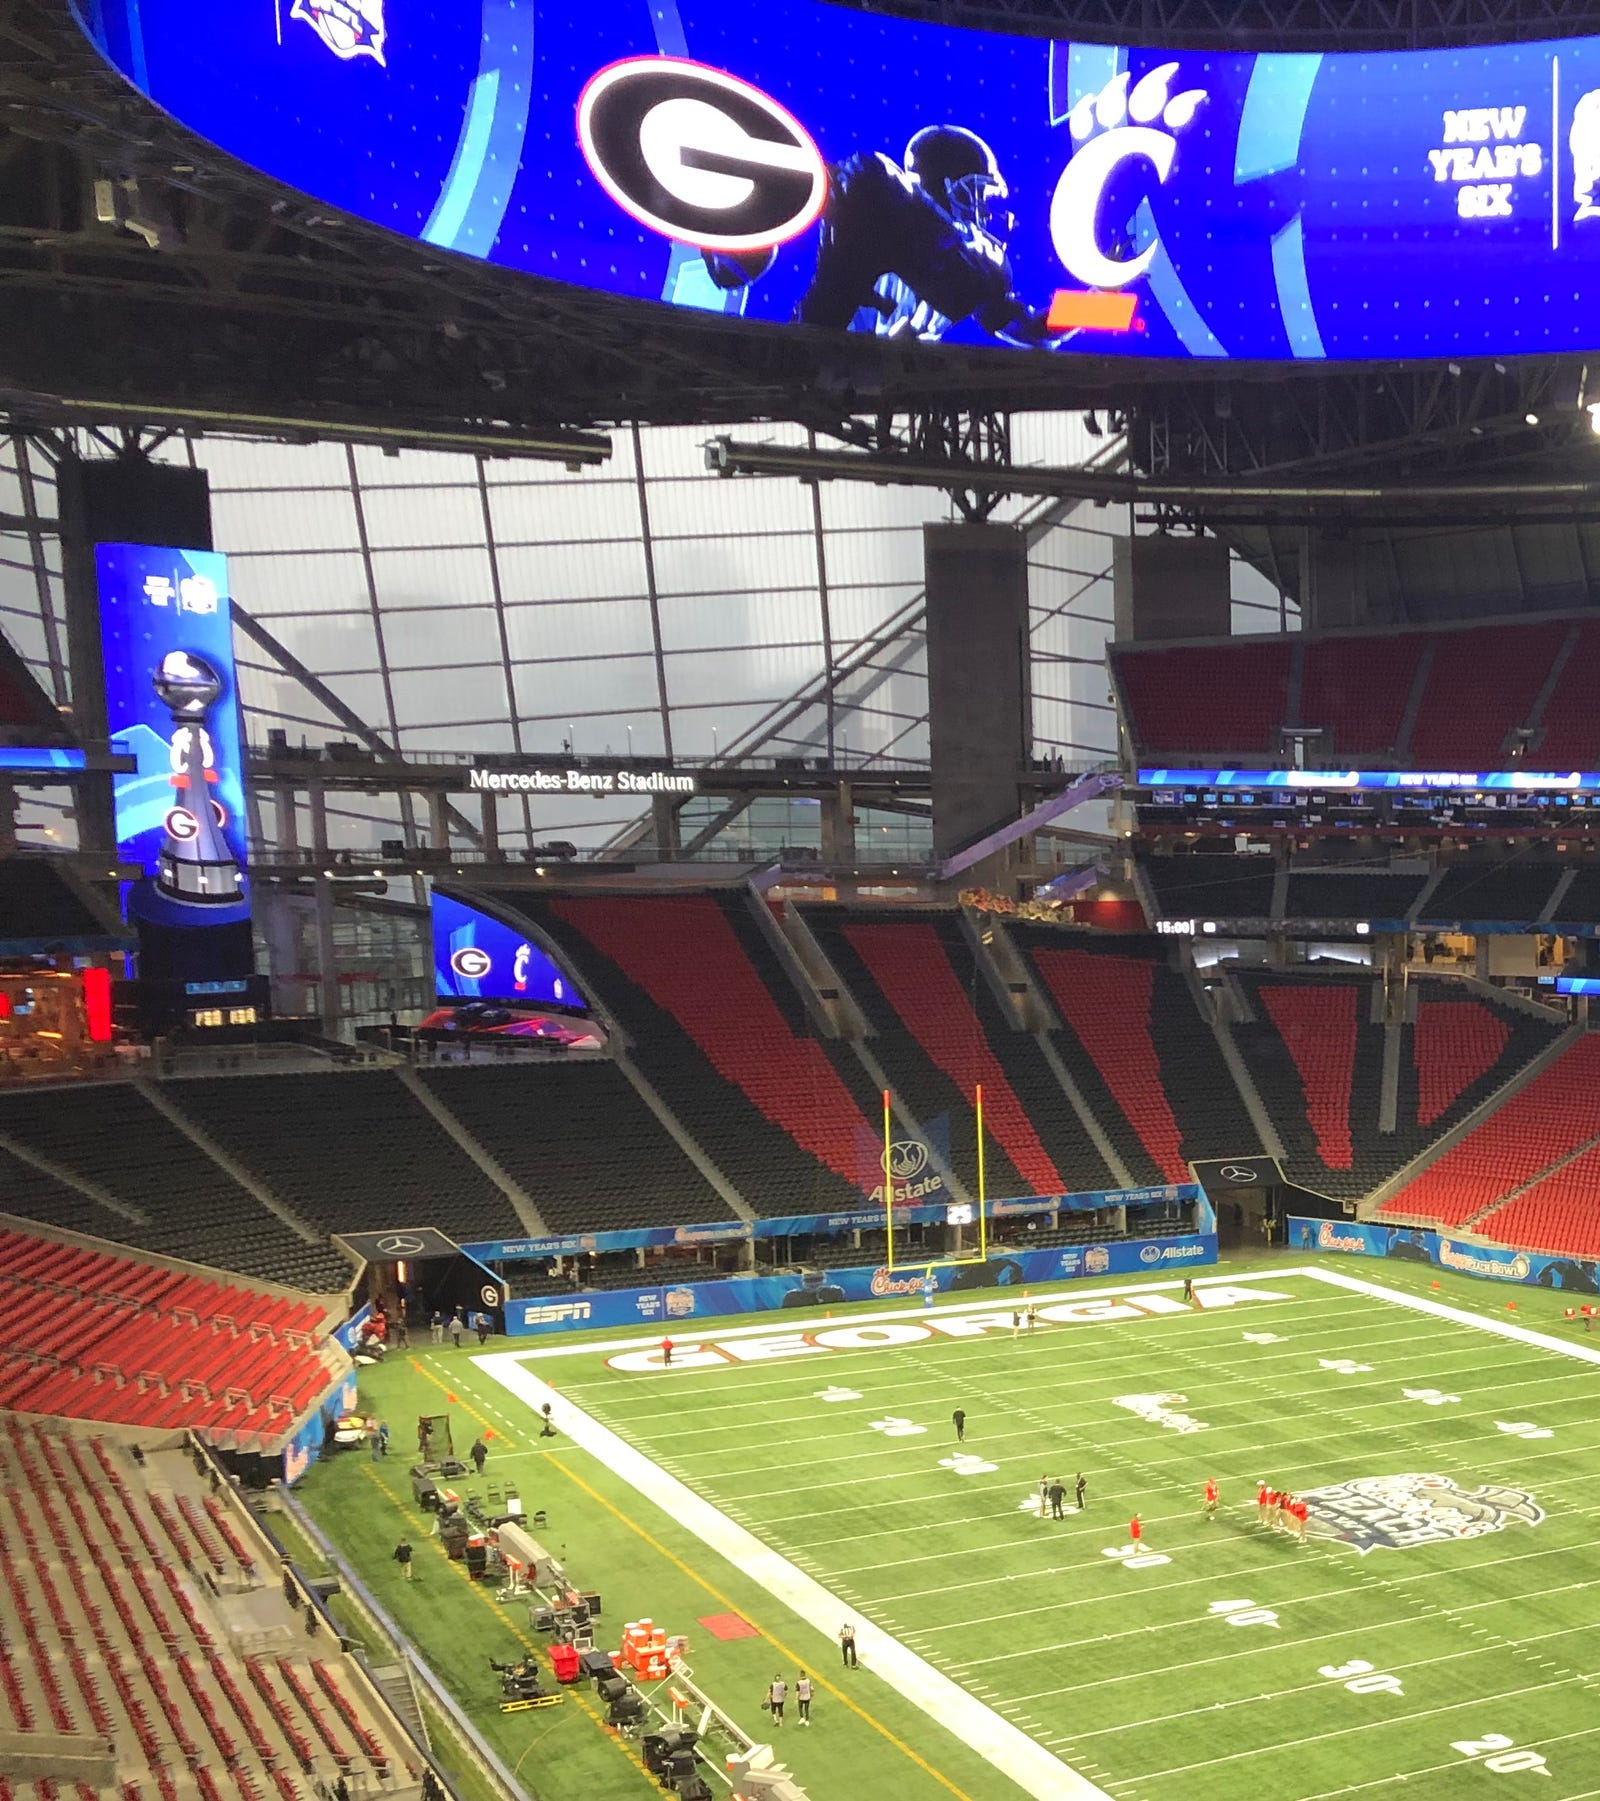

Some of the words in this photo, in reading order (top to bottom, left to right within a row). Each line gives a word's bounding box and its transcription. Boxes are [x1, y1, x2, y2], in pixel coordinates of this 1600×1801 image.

[1442, 105, 1527, 143] NEW
[1428, 143, 1542, 181] YEAR'S
[1457, 183, 1513, 218] SIX
[469, 769, 612, 790] Mercedes-Benz
[618, 771, 694, 791] Stadium
[1156, 921, 1190, 934] 15:00
[869, 1176, 942, 1202] Allstate
[829, 1217, 849, 1226] NEW
[502, 1245, 527, 1254] NEW
[528, 1242, 560, 1252] YEAR'S
[561, 1240, 577, 1249] SIX
[1160, 1245, 1204, 1259] Allstate
[524, 1302, 591, 1325] ESPN
[604, 1286, 1295, 1372] GEORGIA
[1450, 1733, 1548, 1774] 20
